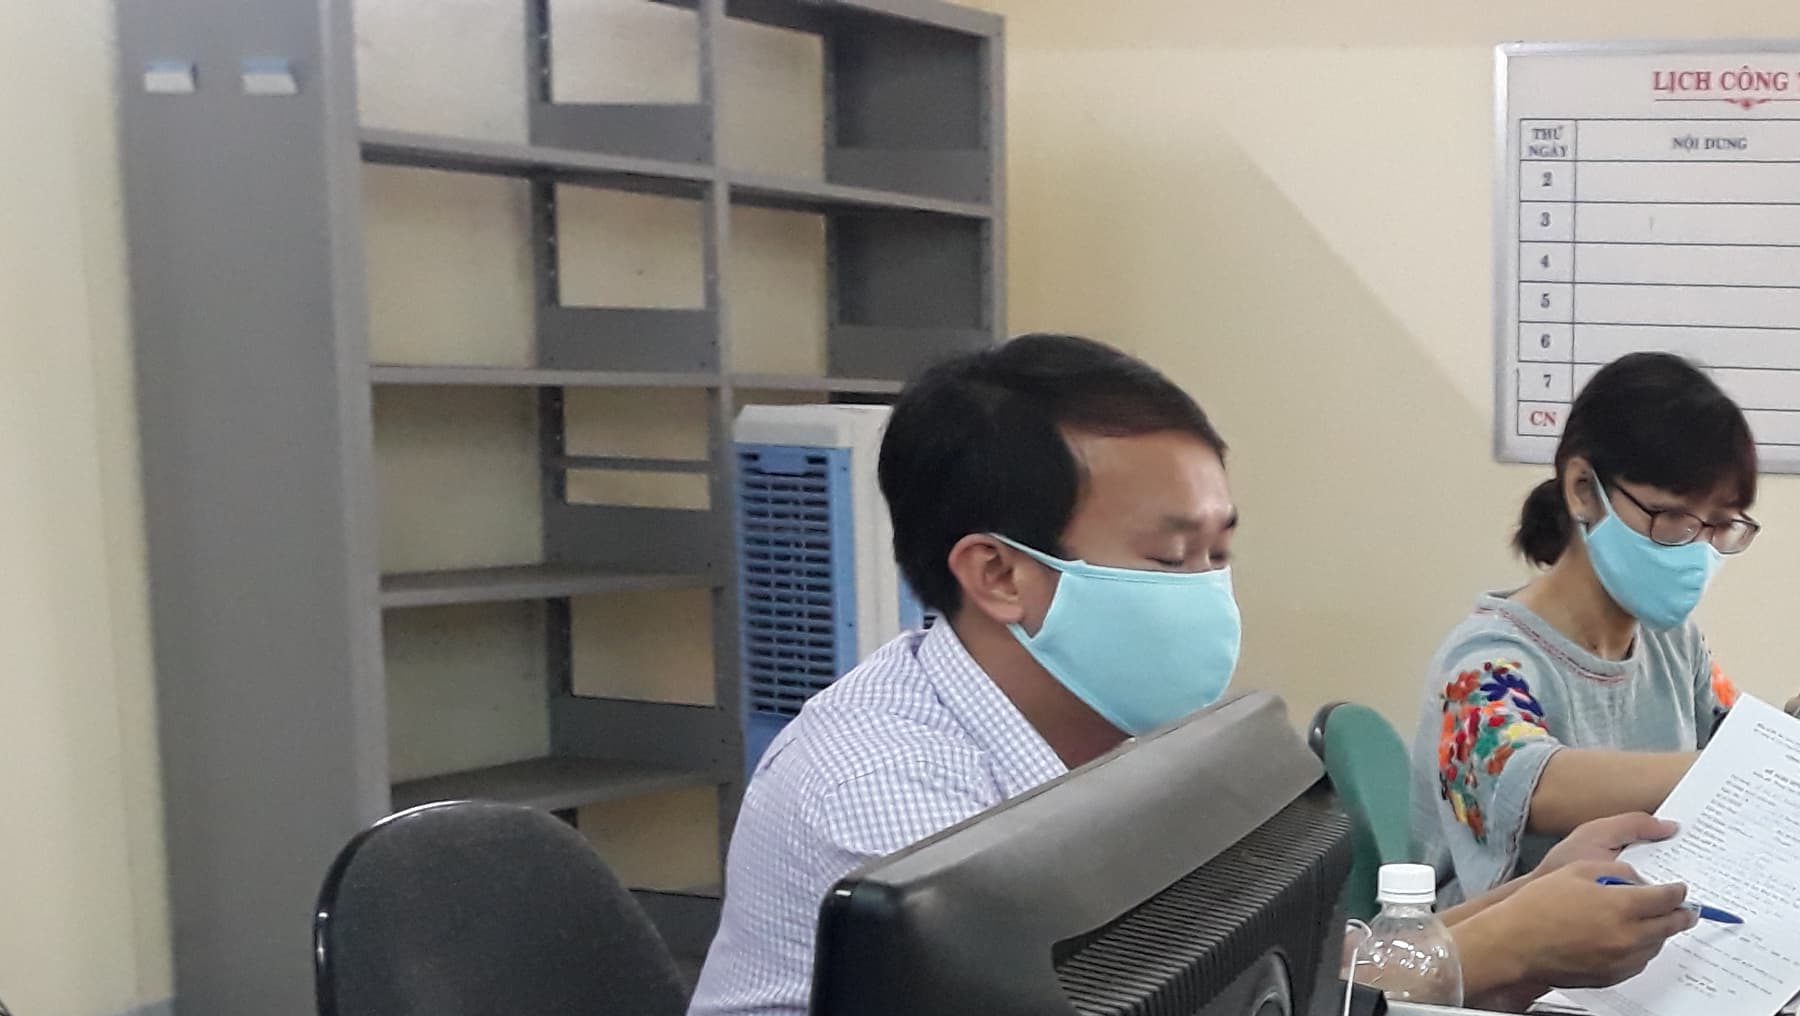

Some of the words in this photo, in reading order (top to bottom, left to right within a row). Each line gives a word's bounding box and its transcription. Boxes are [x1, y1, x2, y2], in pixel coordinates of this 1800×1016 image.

[1652, 71, 1712, 94] LỊCH
[1721, 64, 1788, 93] CÔNG
[1671, 134, 1700, 153] NỘI
[1704, 136, 1748, 150] DUNG
[1542, 172, 1552, 187] 2
[1540, 212, 1550, 227] 3
[1540, 254, 1550, 269] 4
[1540, 293, 1550, 308] 5
[1540, 334, 1551, 349] 6
[1543, 374, 1551, 388] 7
[1530, 411, 1557, 427] CN
